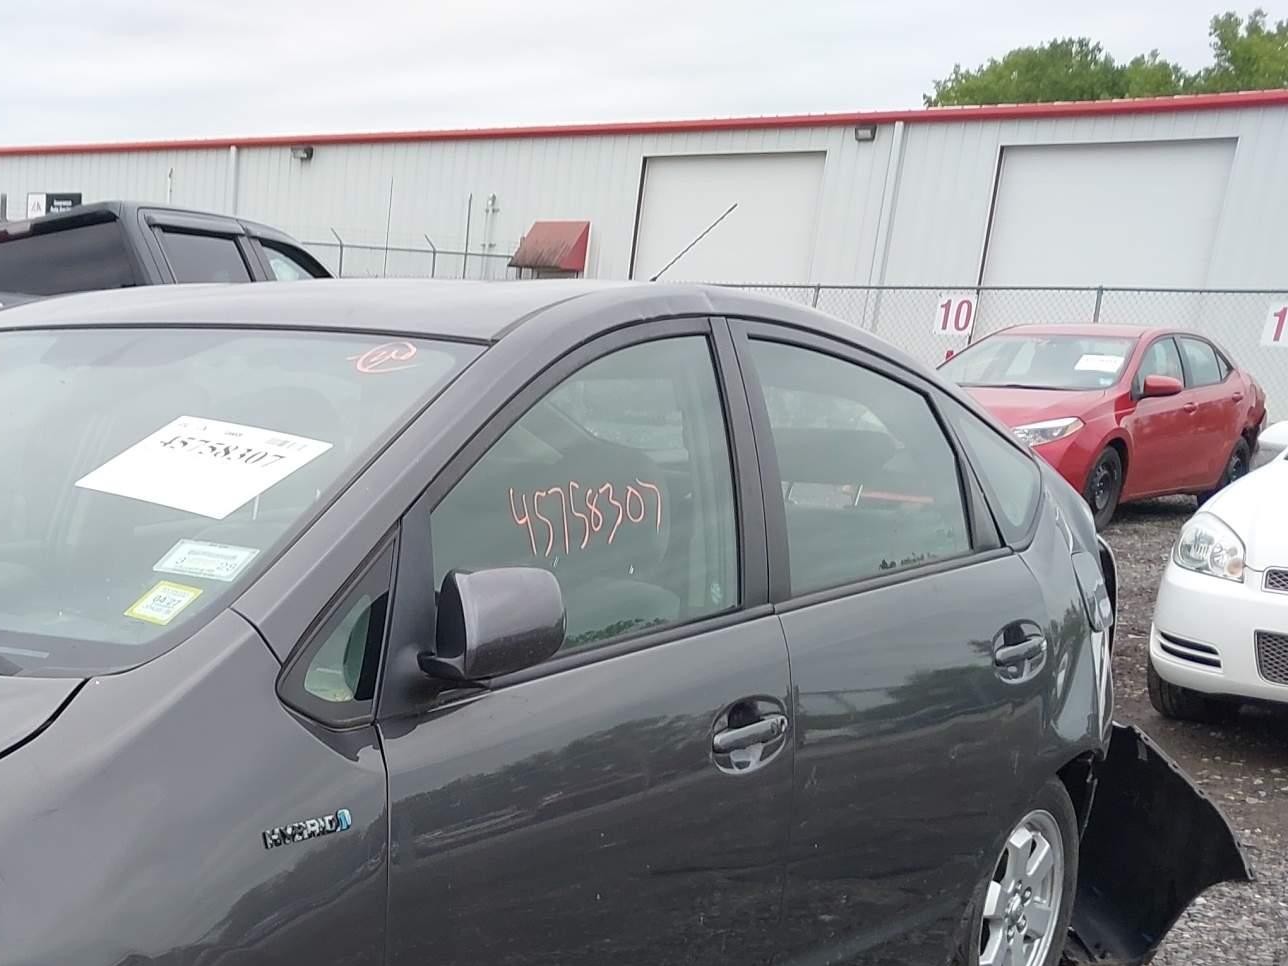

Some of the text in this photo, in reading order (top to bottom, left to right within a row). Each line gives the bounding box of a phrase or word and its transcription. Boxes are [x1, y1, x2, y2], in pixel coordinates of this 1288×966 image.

[939, 298, 973, 332] 10
[160, 436, 287, 467] 45758307
[509, 477, 661, 558] 45758307
[261, 814, 337, 849] HYBRID
